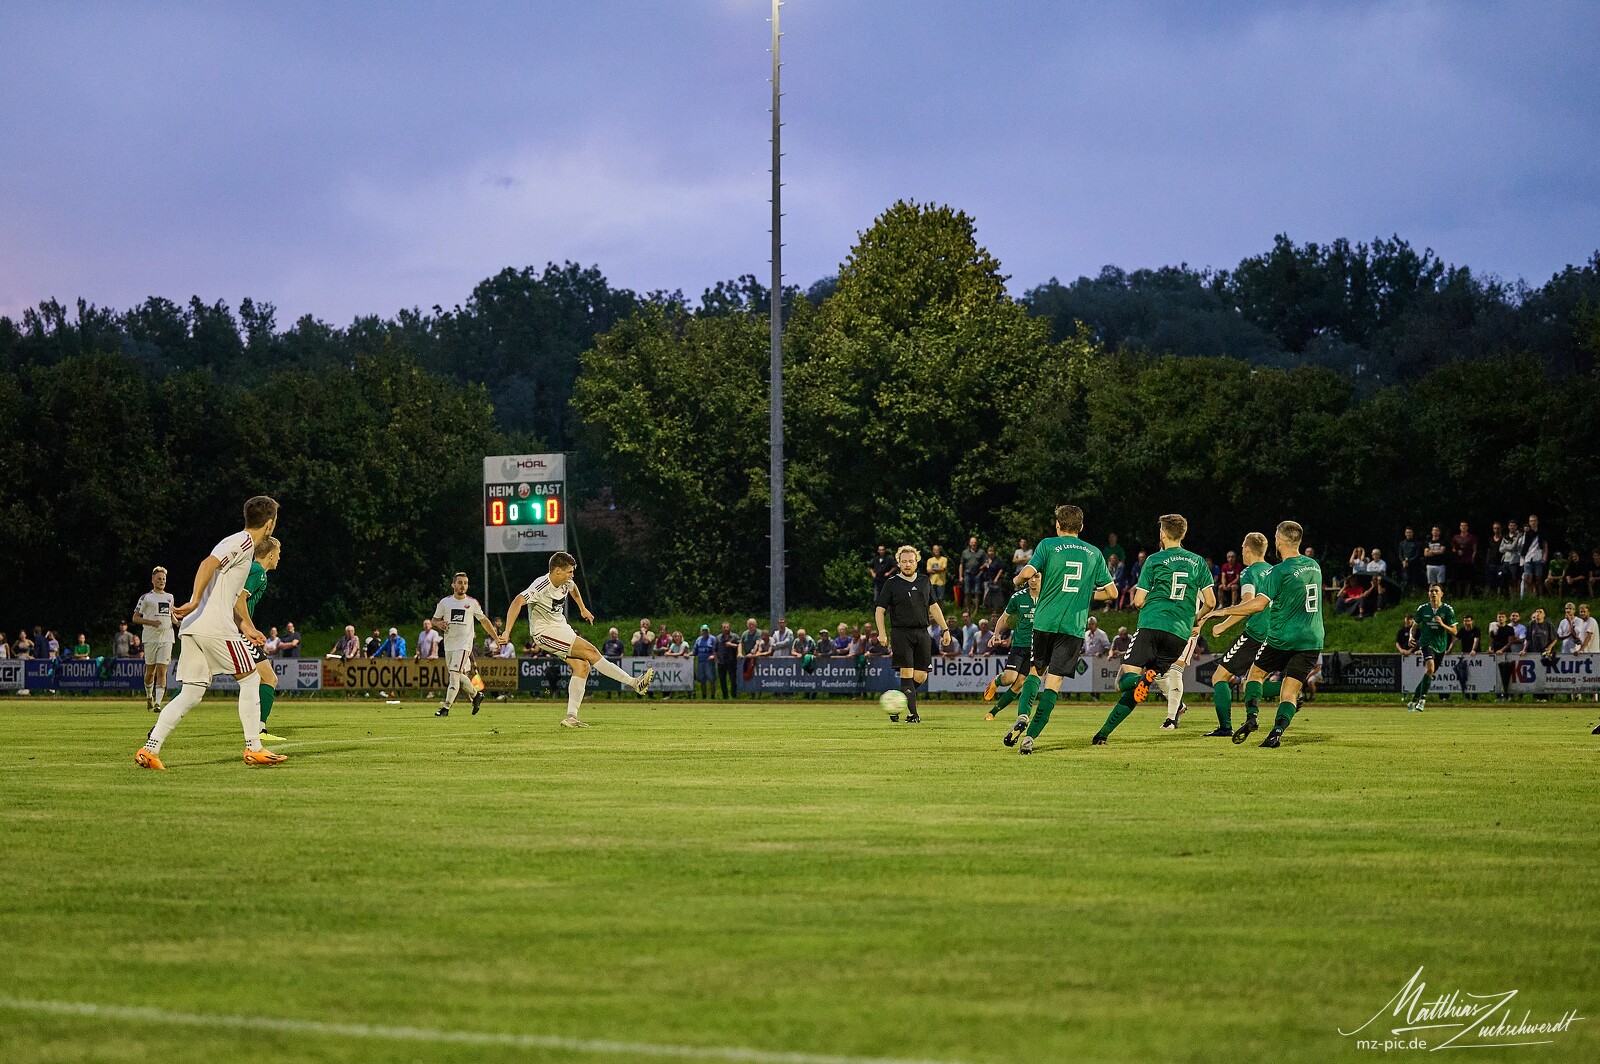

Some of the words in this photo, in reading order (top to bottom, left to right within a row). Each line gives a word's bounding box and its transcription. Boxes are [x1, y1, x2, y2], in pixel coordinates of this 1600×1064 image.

[517, 459, 547, 468] HÖRL
[488, 485, 514, 497] HEIM
[535, 484, 562, 495] GAST
[492, 501, 504, 525] 0
[546, 499, 558, 523] 0
[517, 528, 548, 538] HÖRL
[1062, 561, 1083, 593] 2
[1169, 572, 1189, 601] 6
[1305, 583, 1319, 613] 8
[509, 666, 517, 676] 22
[633, 661, 682, 682] FANK
[933, 658, 989, 676] Heizöl
[1546, 657, 1593, 674] Kurt
[0, 667, 21, 682] er
[1546, 676, 1576, 684] Heizung
[789, 680, 816, 689] Heizung
